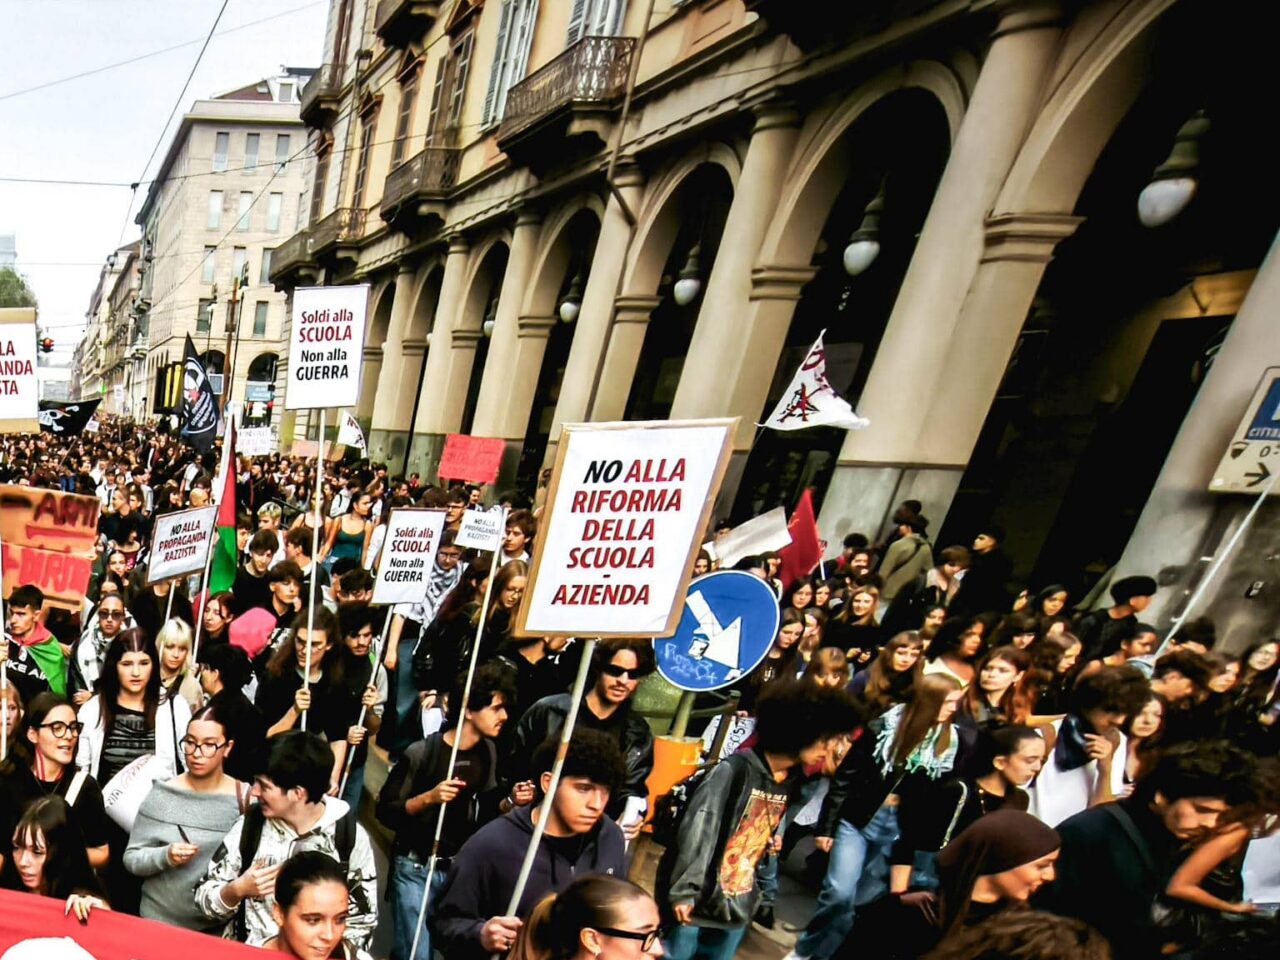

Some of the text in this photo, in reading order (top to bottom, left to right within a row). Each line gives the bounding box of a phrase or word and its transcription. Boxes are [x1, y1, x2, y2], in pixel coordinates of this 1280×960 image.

[301, 308, 353, 324] Soldi alla
[299, 325, 352, 343] SCUOLA
[301, 347, 347, 362] Non alla
[296, 364, 349, 381] GUERRA
[583, 458, 686, 484] NO ALLA
[570, 488, 682, 513] RIFORMA
[170, 520, 201, 536] NO ALLA
[394, 527, 434, 538] Soldi alla
[581, 518, 655, 541] DELLA
[158, 530, 207, 552] PROPAGANDA
[390, 540, 431, 553] SCUOLA
[163, 545, 197, 563] RAZZISTA
[389, 557, 424, 568] Non alla
[566, 546, 655, 569] SCUOLA
[384, 570, 423, 582] GUERRA
[551, 584, 650, 605] AZIENDA
